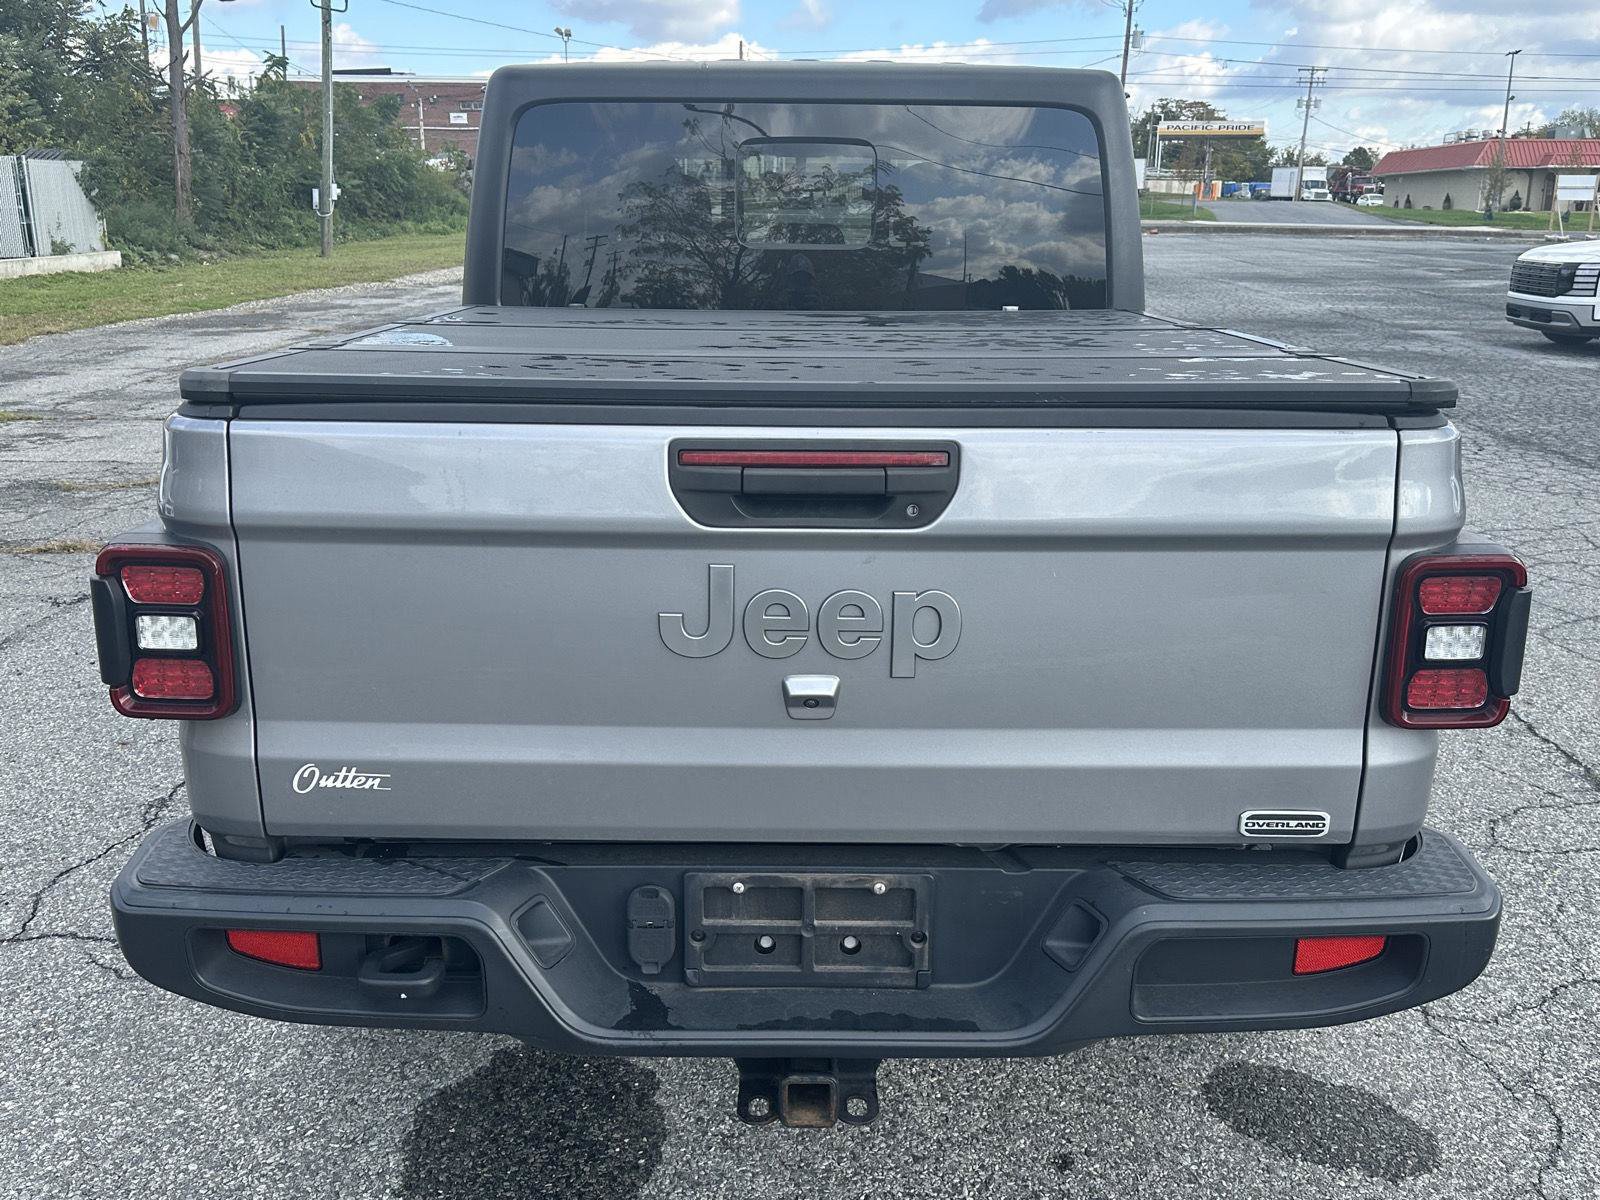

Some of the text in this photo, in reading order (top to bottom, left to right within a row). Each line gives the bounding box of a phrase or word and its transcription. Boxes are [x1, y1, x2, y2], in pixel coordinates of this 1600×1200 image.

[658, 563, 963, 678] Jeep
[292, 763, 391, 794] Outten
[1244, 821, 1326, 829] OVERLAND
